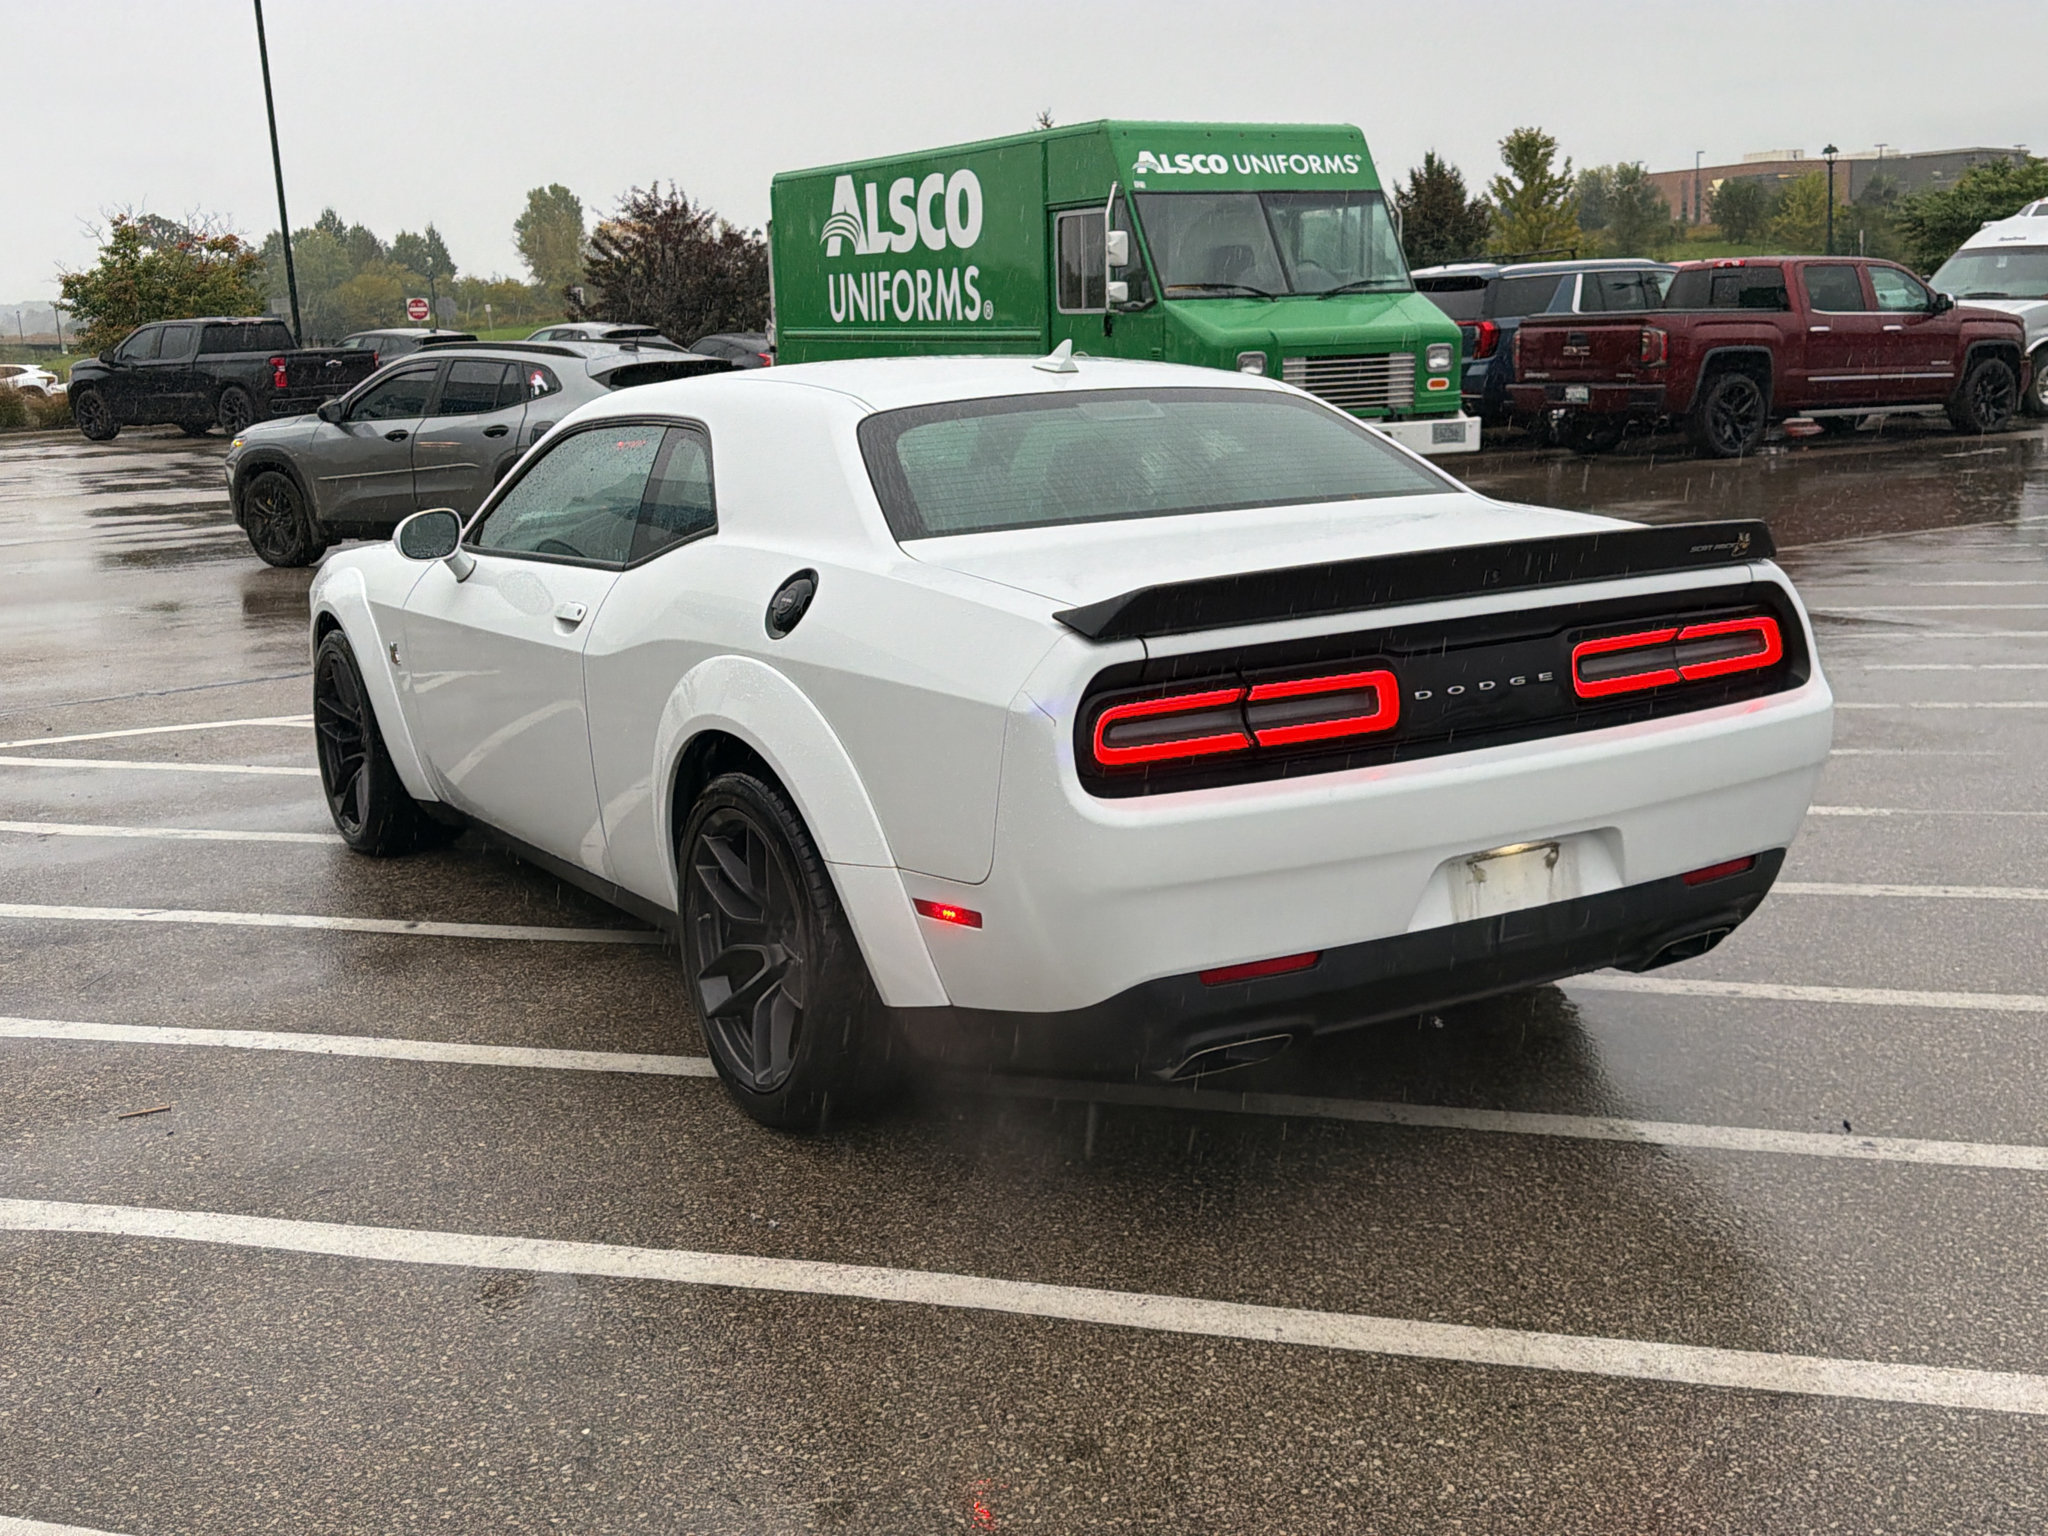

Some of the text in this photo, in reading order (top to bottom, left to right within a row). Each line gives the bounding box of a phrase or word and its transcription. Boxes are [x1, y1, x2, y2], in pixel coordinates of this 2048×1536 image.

[1132, 150, 1229, 175] ALSCO
[819, 168, 984, 258] ALSCO
[1413, 671, 1554, 701] DODGE
